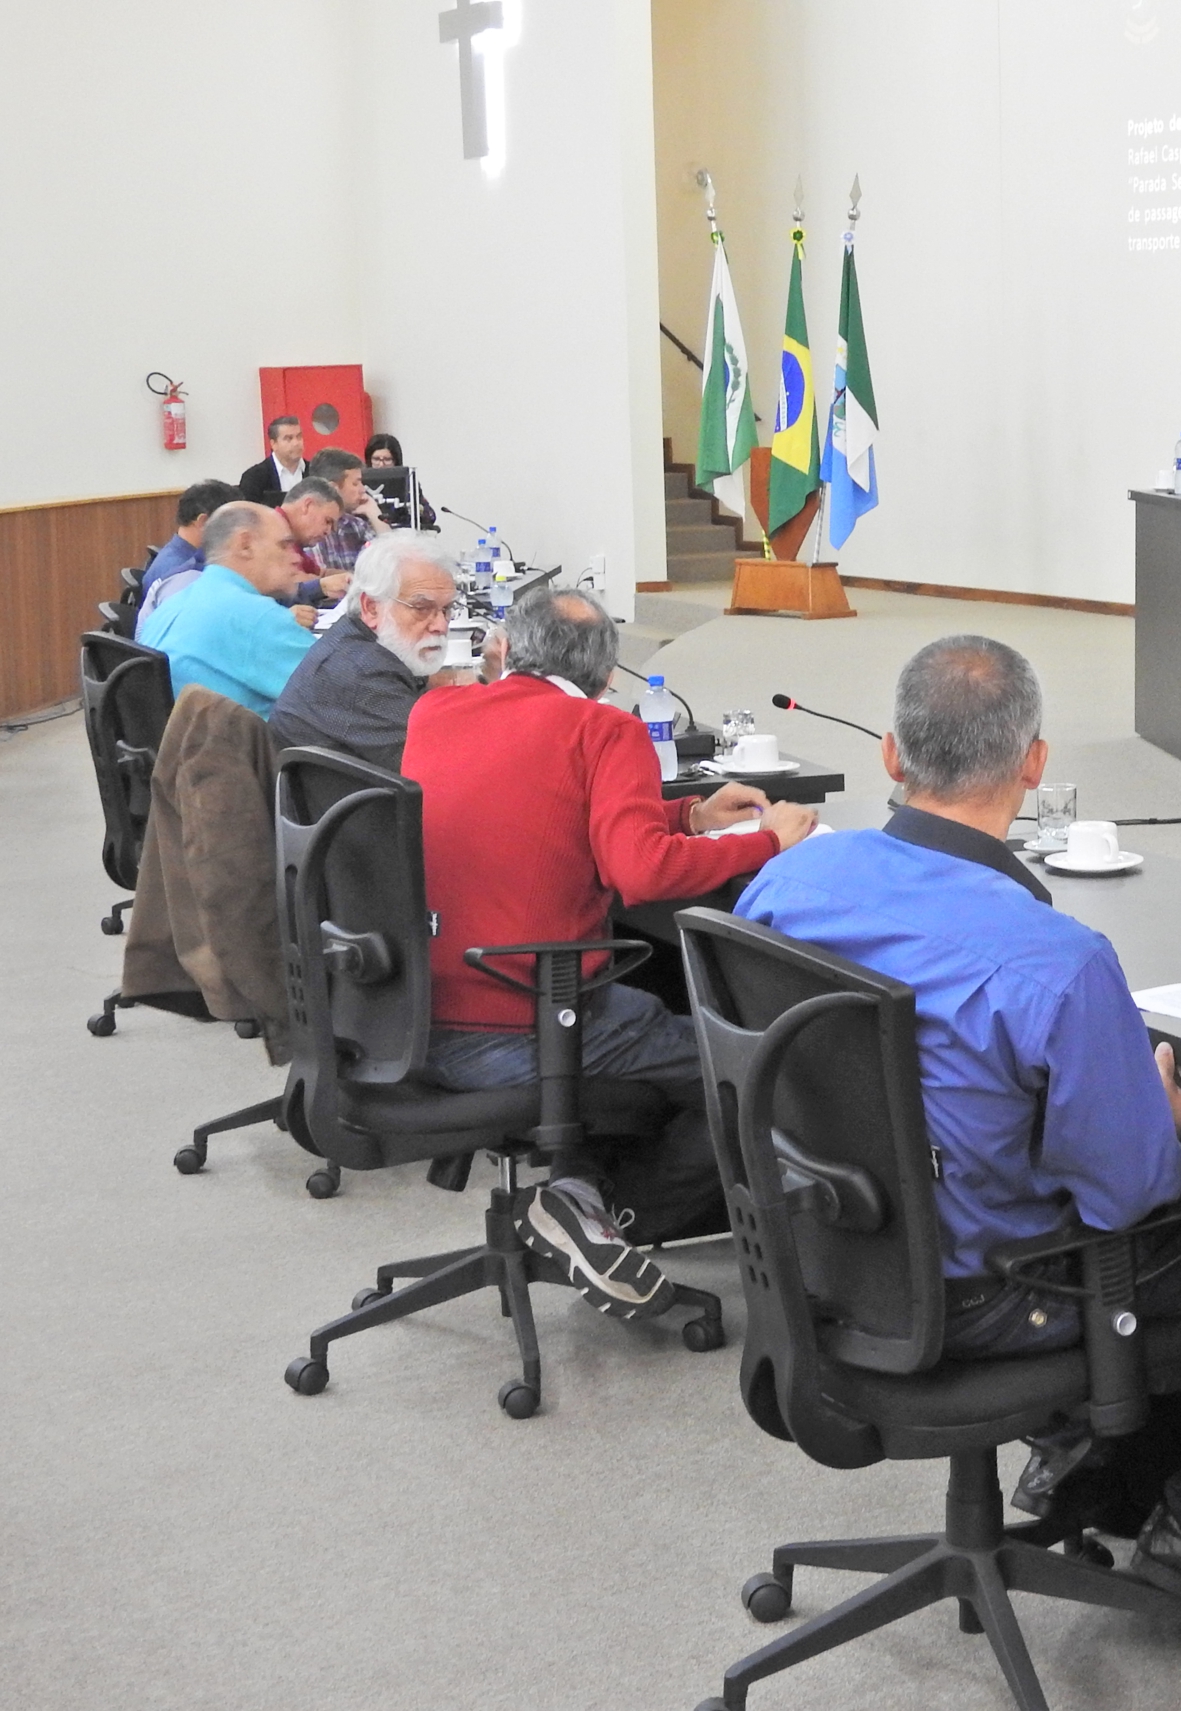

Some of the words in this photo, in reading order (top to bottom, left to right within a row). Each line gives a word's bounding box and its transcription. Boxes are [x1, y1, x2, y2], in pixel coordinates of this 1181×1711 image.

[1127, 117, 1165, 139] Projeto
[1128, 144, 1158, 165] Rafael
[1128, 206, 1141, 223] de
[1128, 233, 1181, 253] transporte
